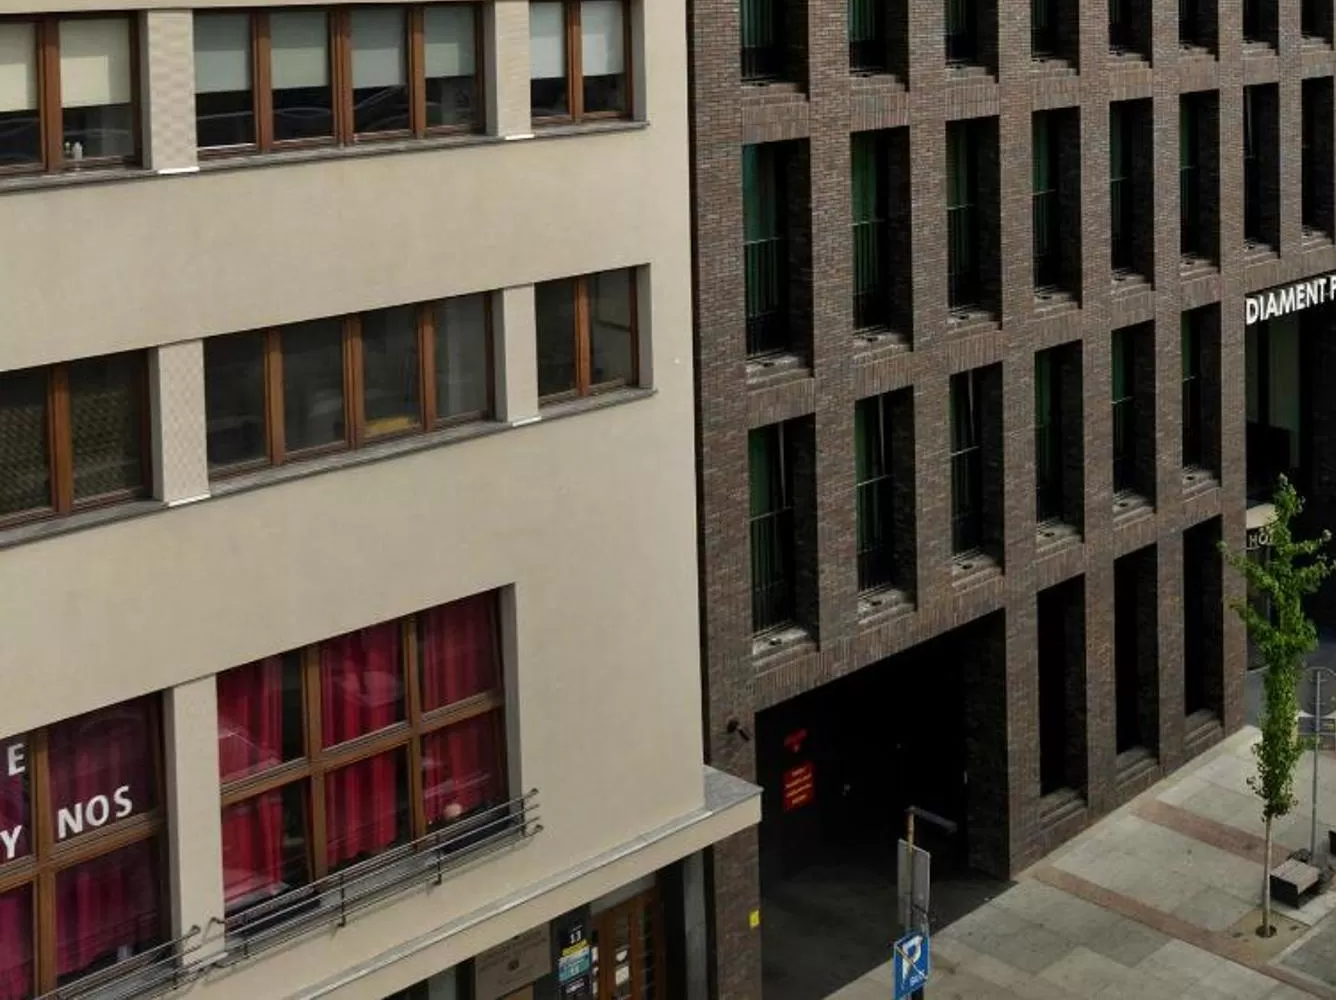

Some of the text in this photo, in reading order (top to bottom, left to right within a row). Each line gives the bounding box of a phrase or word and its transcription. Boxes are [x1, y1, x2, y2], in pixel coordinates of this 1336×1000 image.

[1245, 278, 1327, 326] DIAMENT
[7, 743, 26, 776] E
[57, 785, 133, 839] NOS
